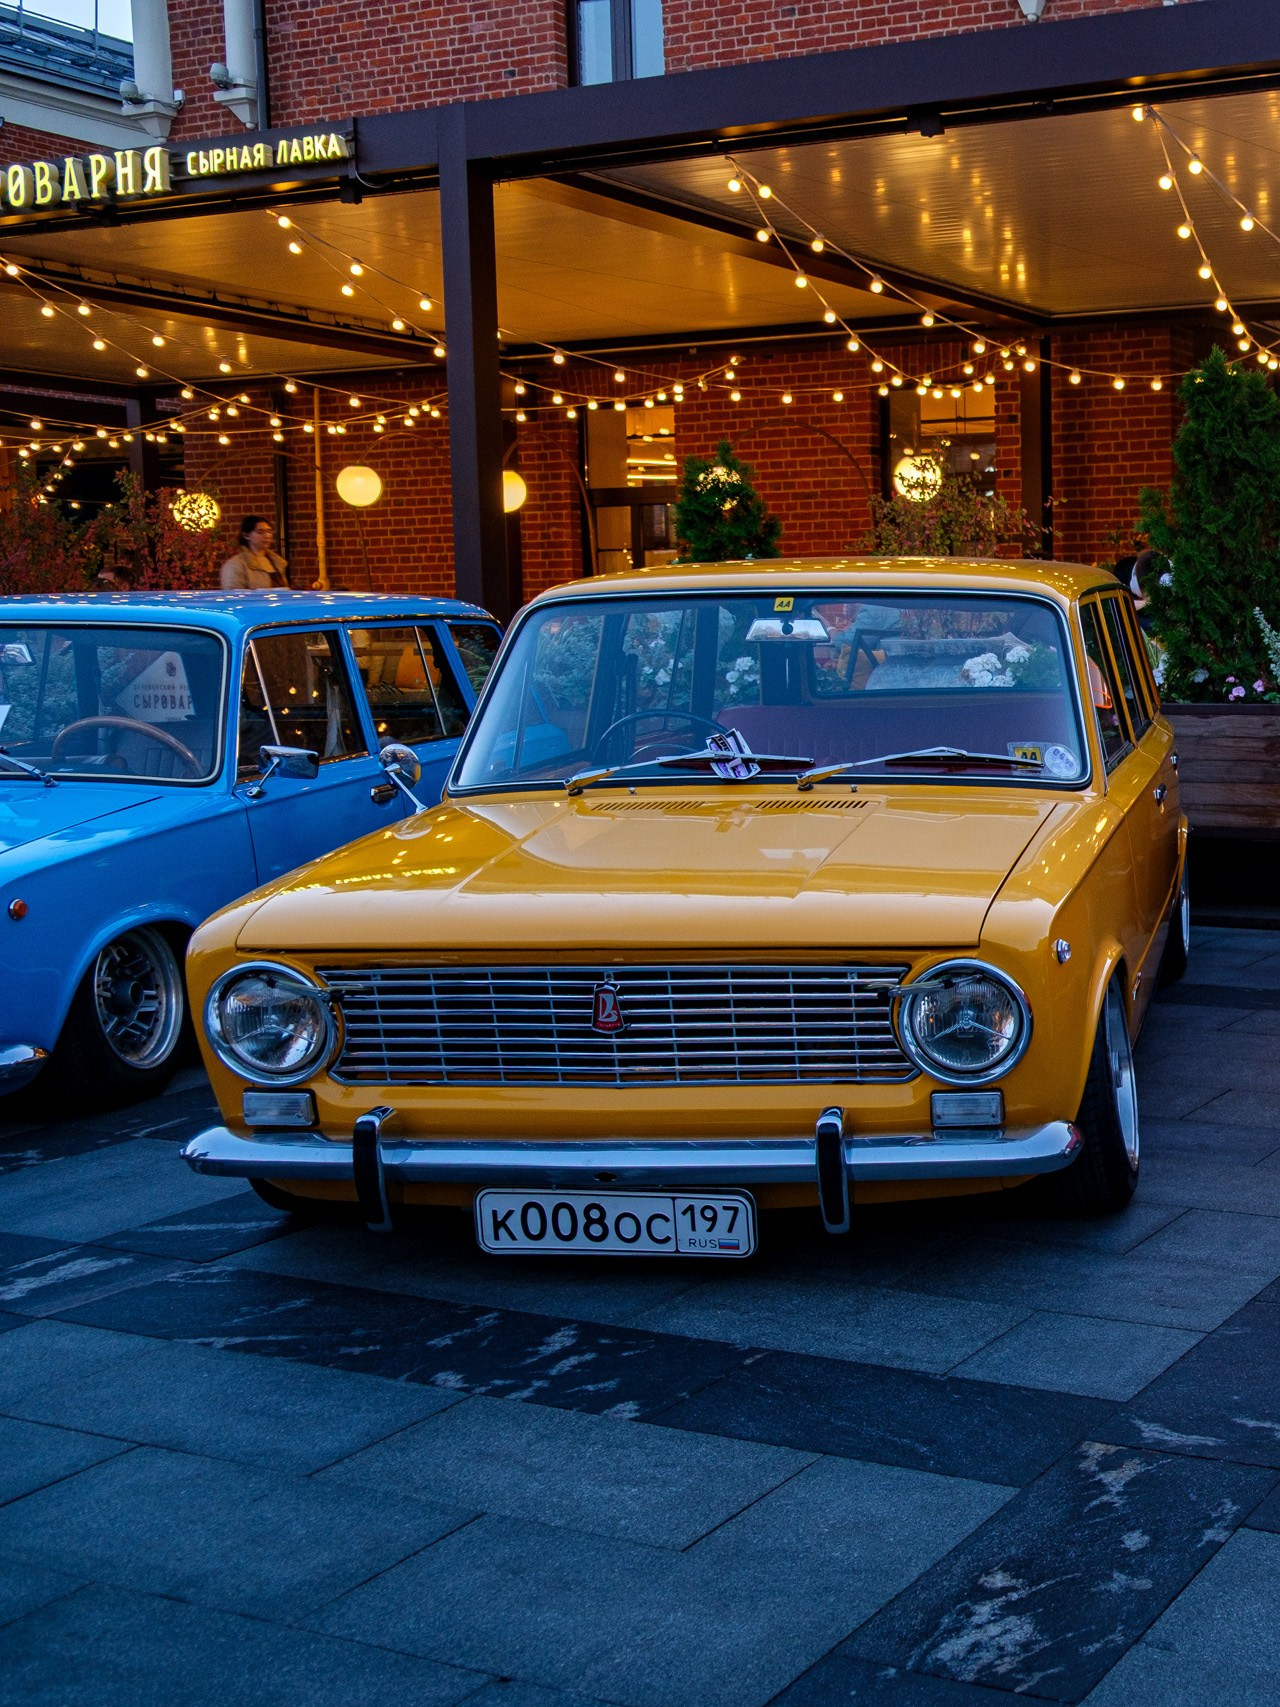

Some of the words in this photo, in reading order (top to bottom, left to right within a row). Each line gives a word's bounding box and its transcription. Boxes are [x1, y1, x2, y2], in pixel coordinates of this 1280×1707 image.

[186, 143, 270, 176] СЫРНАЯ
[276, 133, 348, 165] ЛАВКА
[0, 146, 169, 209] ОВАРНЯ
[776, 600, 791, 608] AA
[680, 1204, 741, 1234] 197
[688, 1238, 718, 1249] RUS
